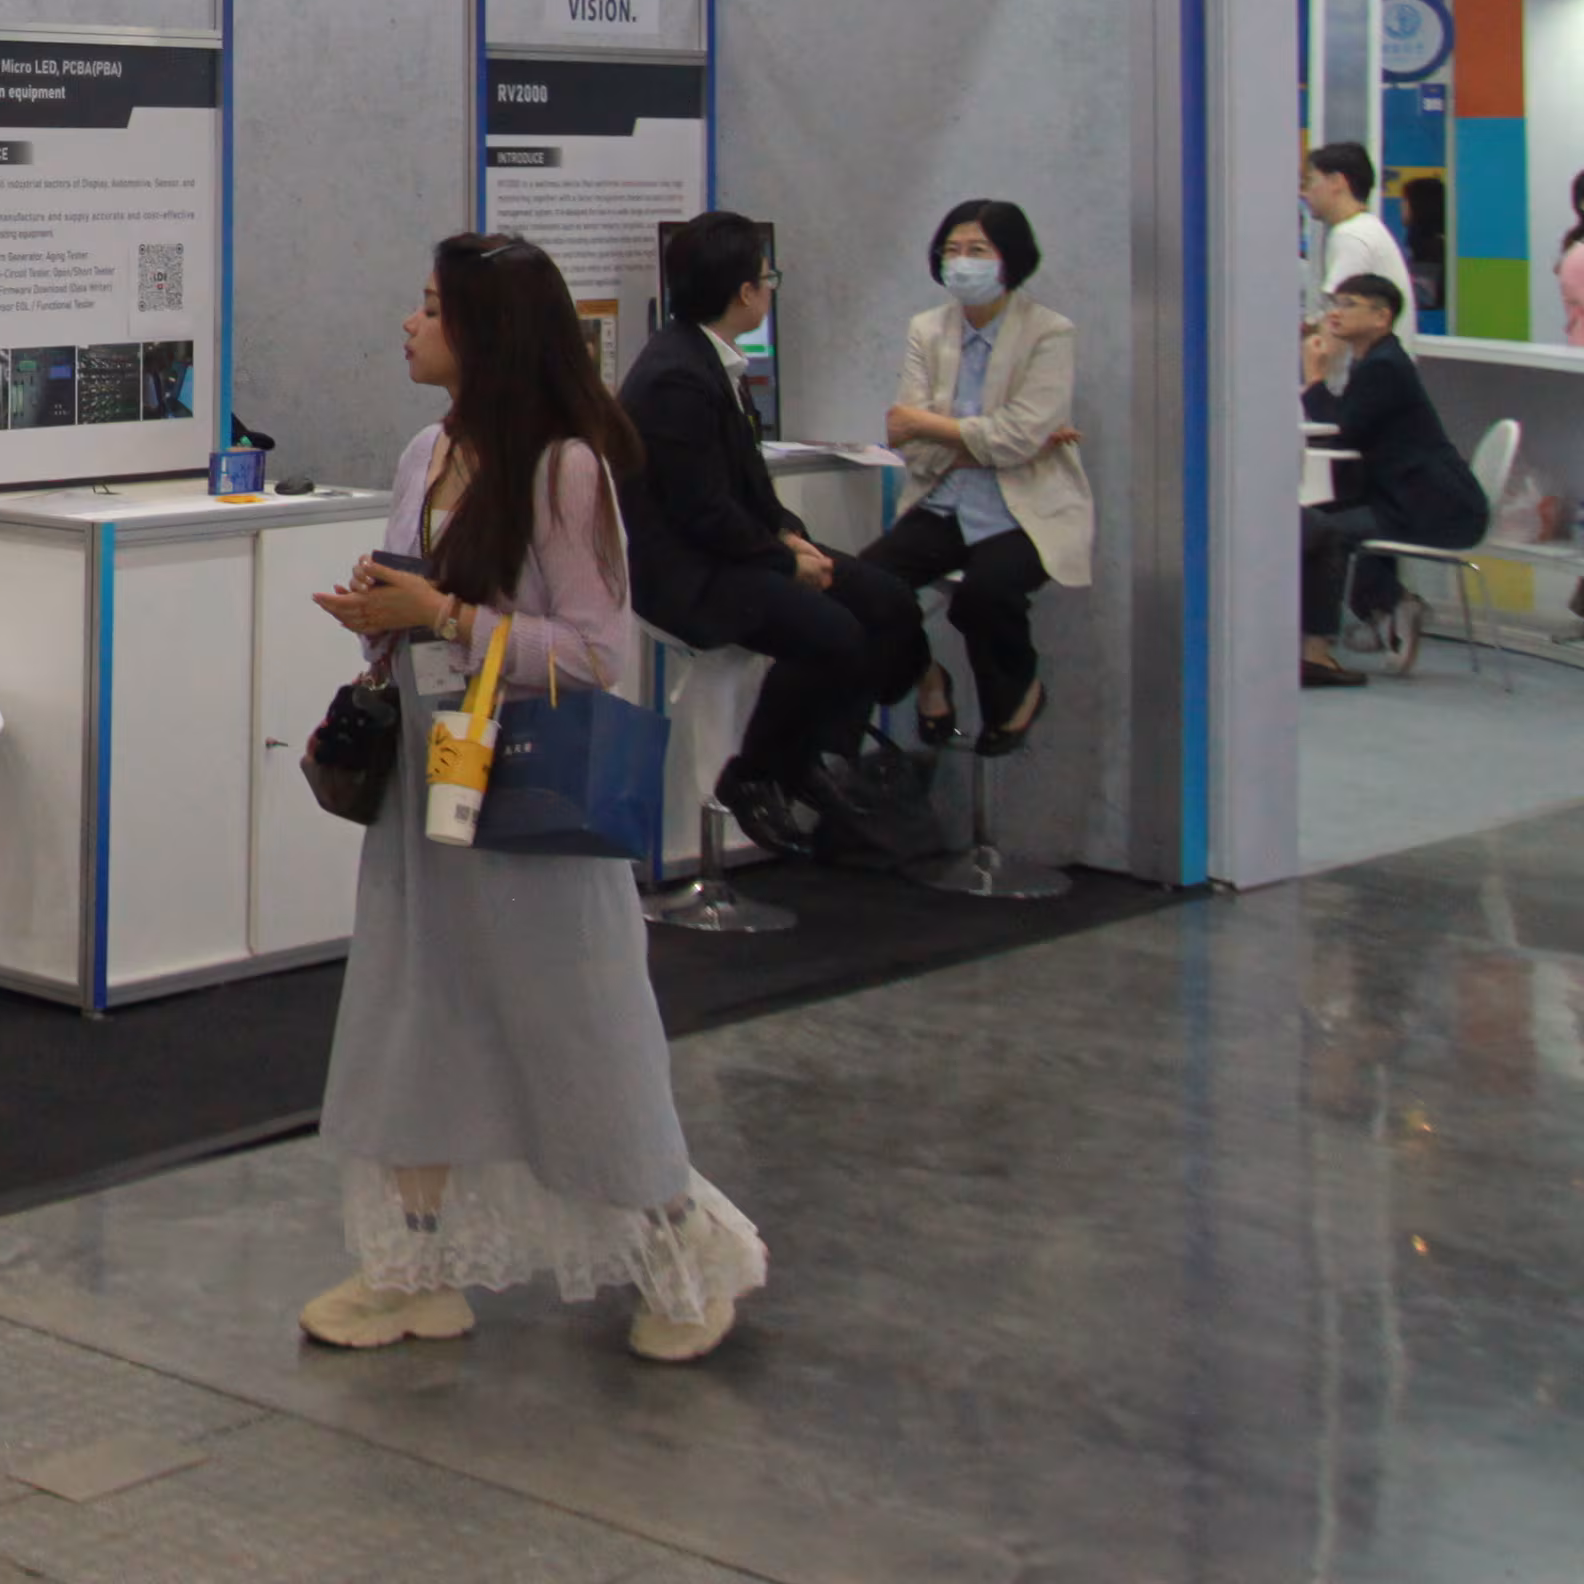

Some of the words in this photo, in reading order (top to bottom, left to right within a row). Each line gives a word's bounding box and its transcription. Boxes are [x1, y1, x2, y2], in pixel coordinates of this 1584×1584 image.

[0, 58, 33, 74] Micro
[34, 59, 60, 77] LED,
[62, 60, 123, 78] PCBA(PBA)
[8, 84, 66, 103] equipment
[497, 83, 549, 104] RV2000
[496, 151, 545, 165] INTRODUCE
